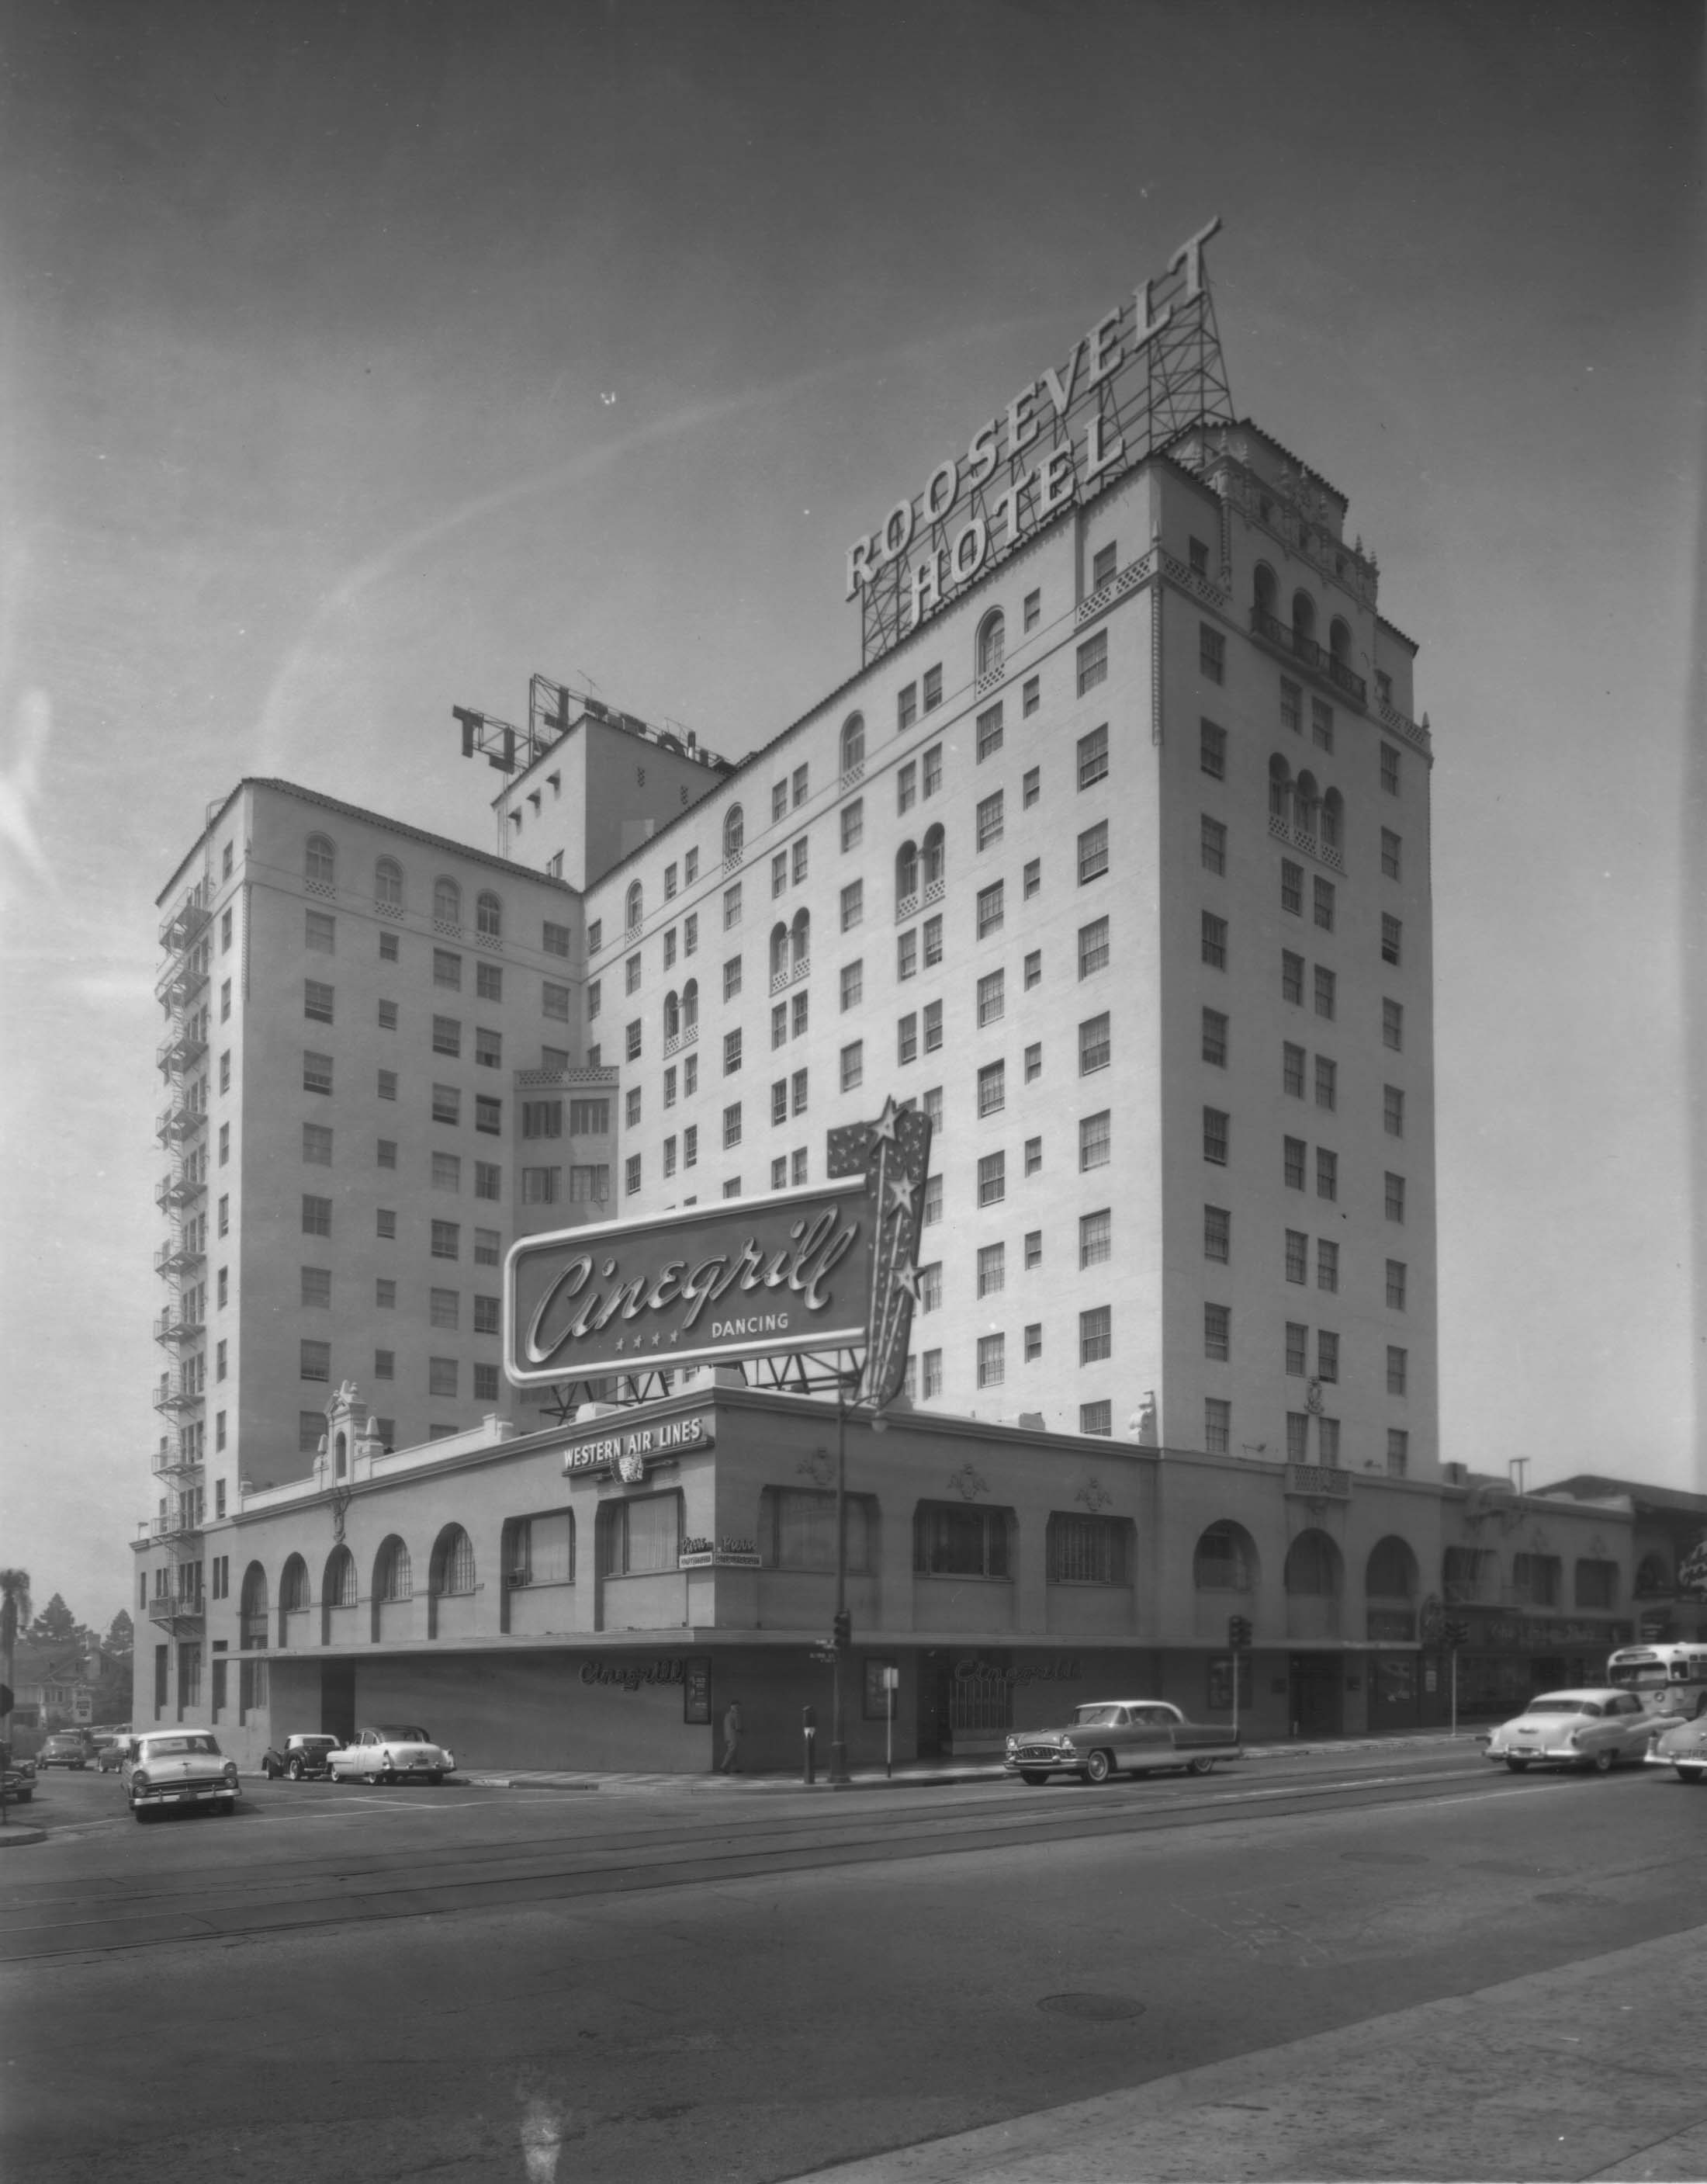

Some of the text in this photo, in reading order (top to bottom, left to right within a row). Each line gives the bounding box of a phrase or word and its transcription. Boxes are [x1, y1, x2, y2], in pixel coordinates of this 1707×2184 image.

[844, 216, 1221, 601] ROOSEVELT
[909, 414, 1125, 627] HOTEL
[525, 1204, 858, 1364] Cinegrill
[712, 1312, 789, 1339] DANCING
[564, 1417, 702, 1468] WESTERN AIR LINES
